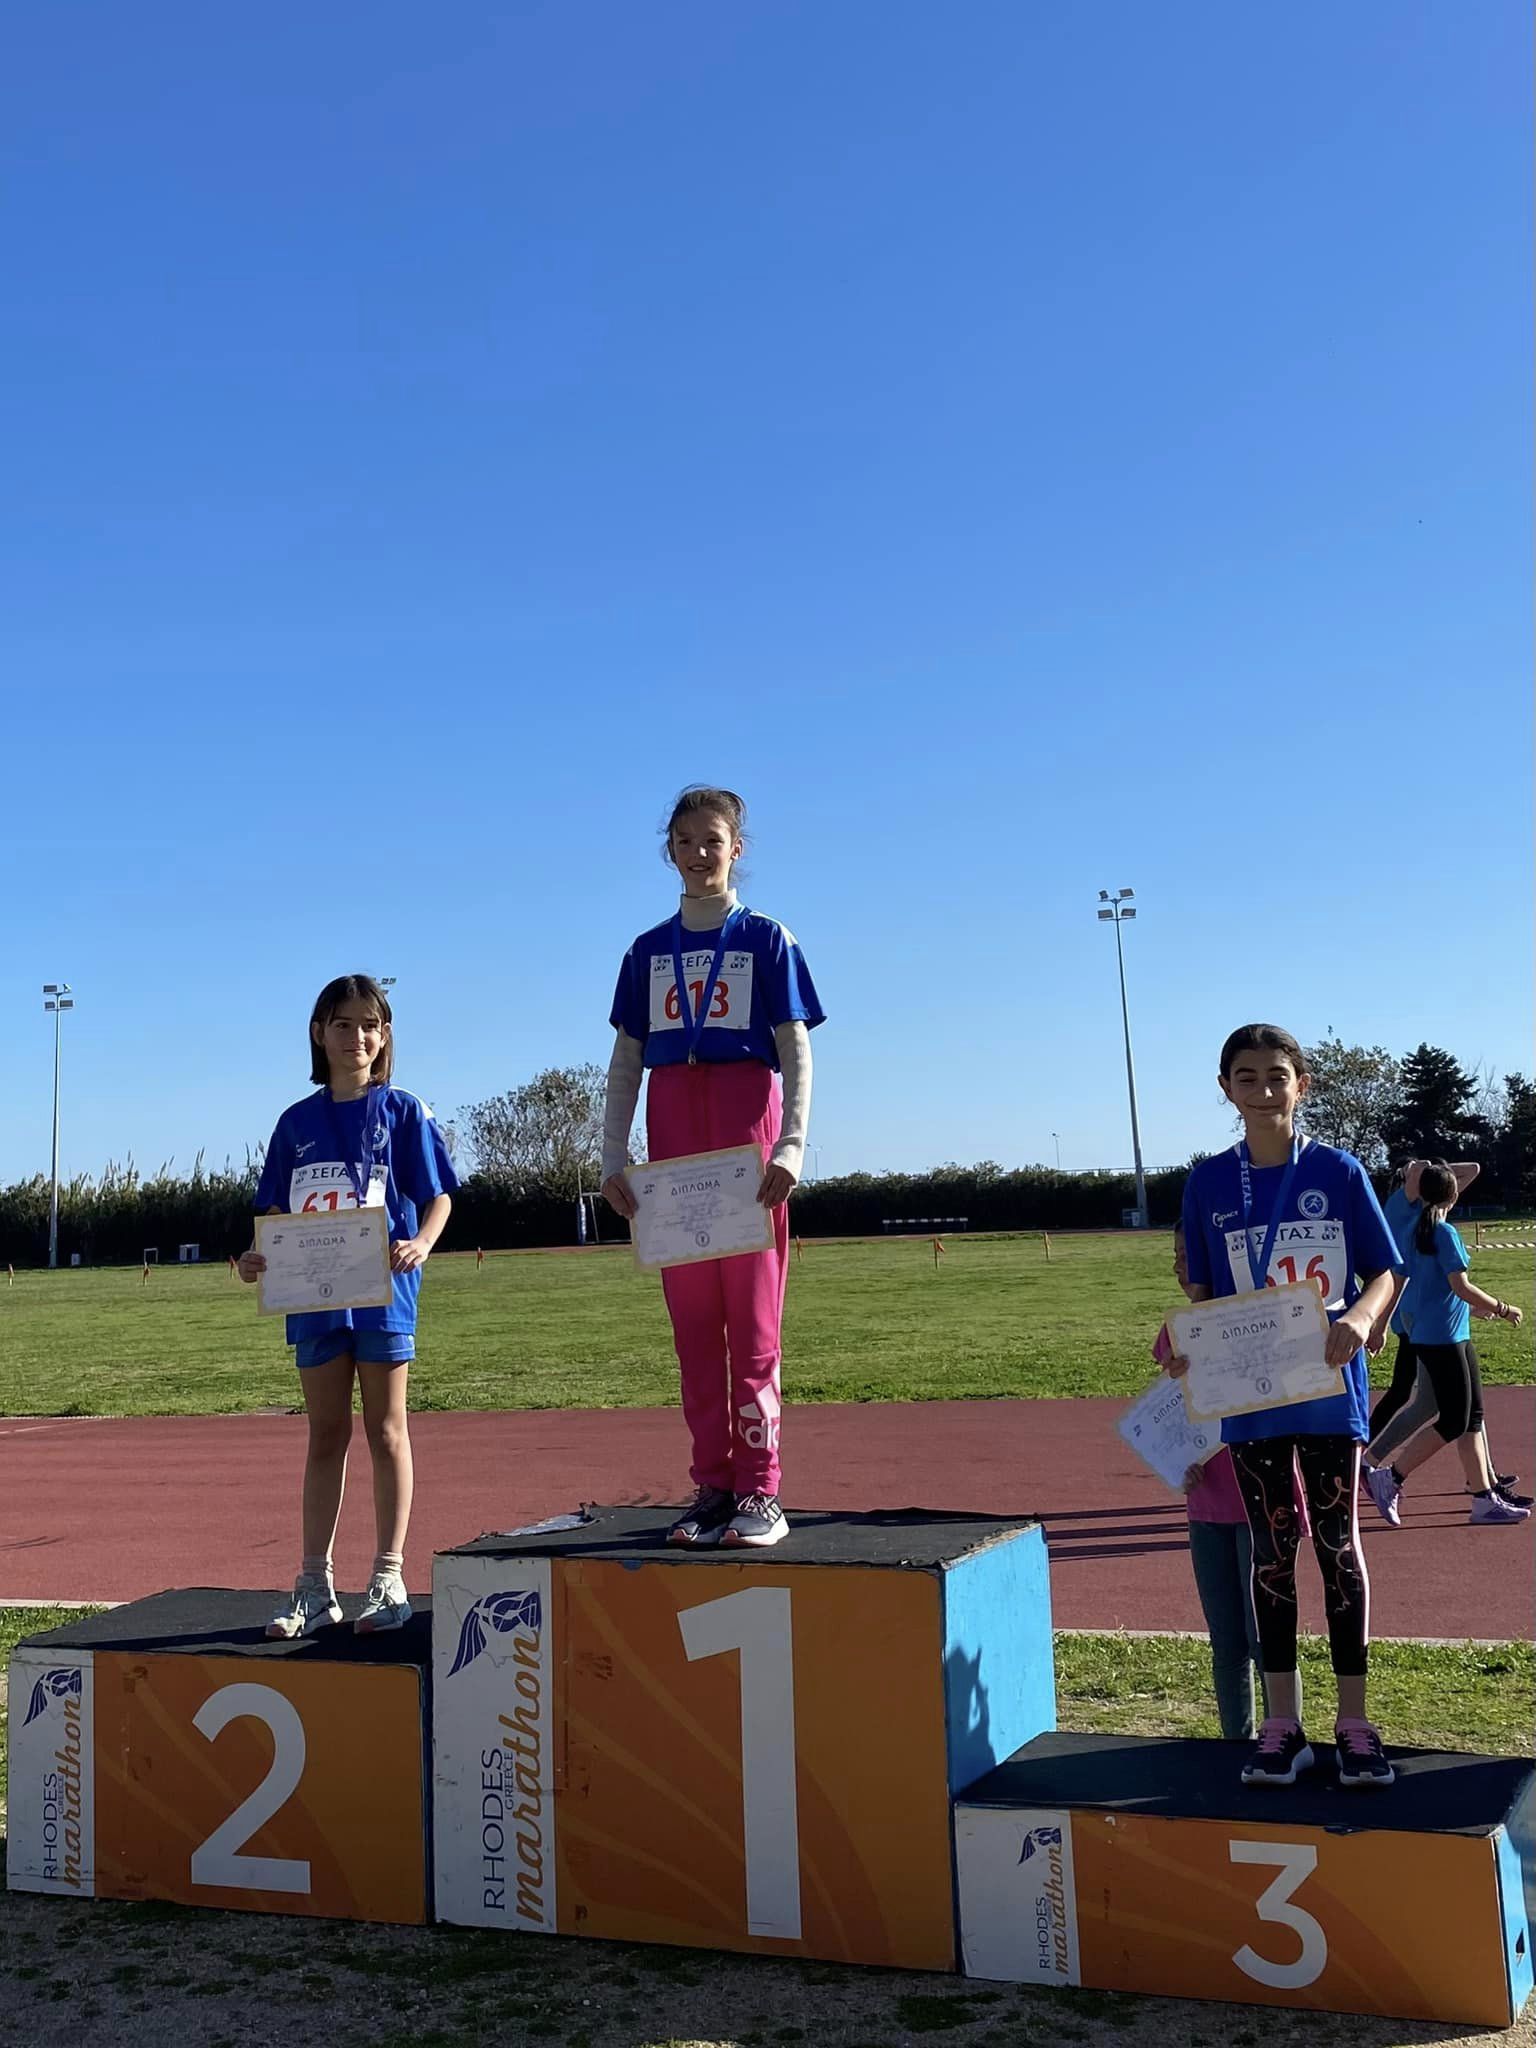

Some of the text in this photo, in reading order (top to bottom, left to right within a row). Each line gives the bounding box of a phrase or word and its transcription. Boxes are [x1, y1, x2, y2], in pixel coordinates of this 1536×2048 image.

[681, 954, 724, 969] ΕΓΑ
[664, 979, 730, 1021] 613
[311, 1166, 361, 1180] ΣΕΓΑ
[671, 1179, 721, 1196] ΔΙΠΛΩΜΑ
[298, 1235, 347, 1249] ΔΙΠΛΩΜΑ
[1255, 1226, 1316, 1246] ΣΓΑΣ
[1264, 1254, 1331, 1299] 16
[1221, 1319, 1279, 1341] ΔΙΠΛΩΜΑ
[1153, 1392, 1184, 1425] ΔΙΠΛΩΜ
[55, 1694, 82, 1890] marathon
[191, 1682, 311, 1895] 2
[498, 1629, 544, 1924] marathon
[504, 1752, 514, 1812] GREECE
[677, 1586, 801, 1939] 1
[43, 1772, 57, 1881] RHODES
[481, 1748, 505, 1911] RHODES
[1035, 1896, 1050, 1969] RHODES
[1044, 1844, 1069, 1976] marathon
[1229, 1839, 1328, 1989] 3
